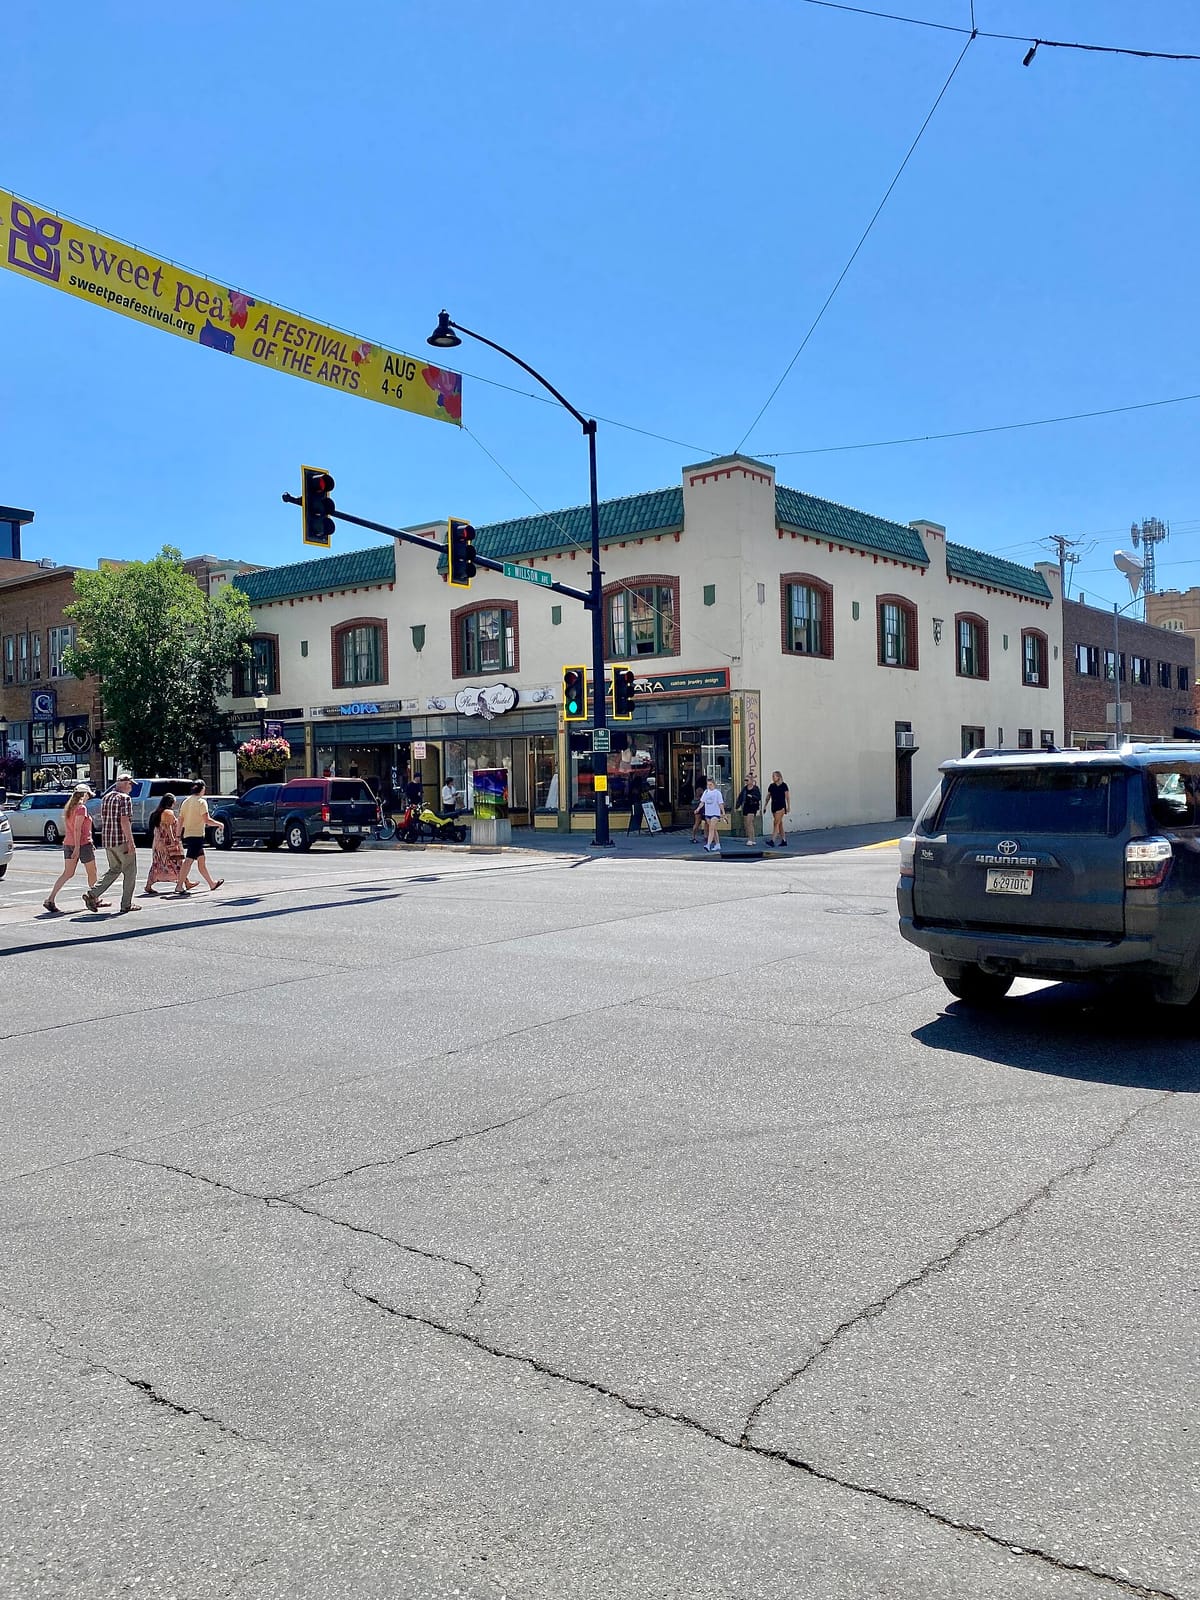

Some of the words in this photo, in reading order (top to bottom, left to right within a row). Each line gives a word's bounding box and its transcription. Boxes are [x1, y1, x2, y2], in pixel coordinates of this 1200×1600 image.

[67, 238, 165, 298] sweet
[173, 280, 225, 321] pea
[68, 274, 196, 336] sweetpeafestival.org
[253, 313, 270, 335] A
[272, 319, 349, 364] FESTIVAL
[251, 337, 278, 361] OF
[281, 346, 313, 375] THE
[316, 361, 361, 390] ARTS
[383, 354, 417, 382] AUG
[381, 379, 403, 399] 4-6
[514, 566, 538, 582] WILLSON
[541, 575, 549, 585] AVE
[341, 702, 379, 716] MOKA
[459, 694, 479, 708] Plum
[976, 854, 1037, 866] 4RUNNER
